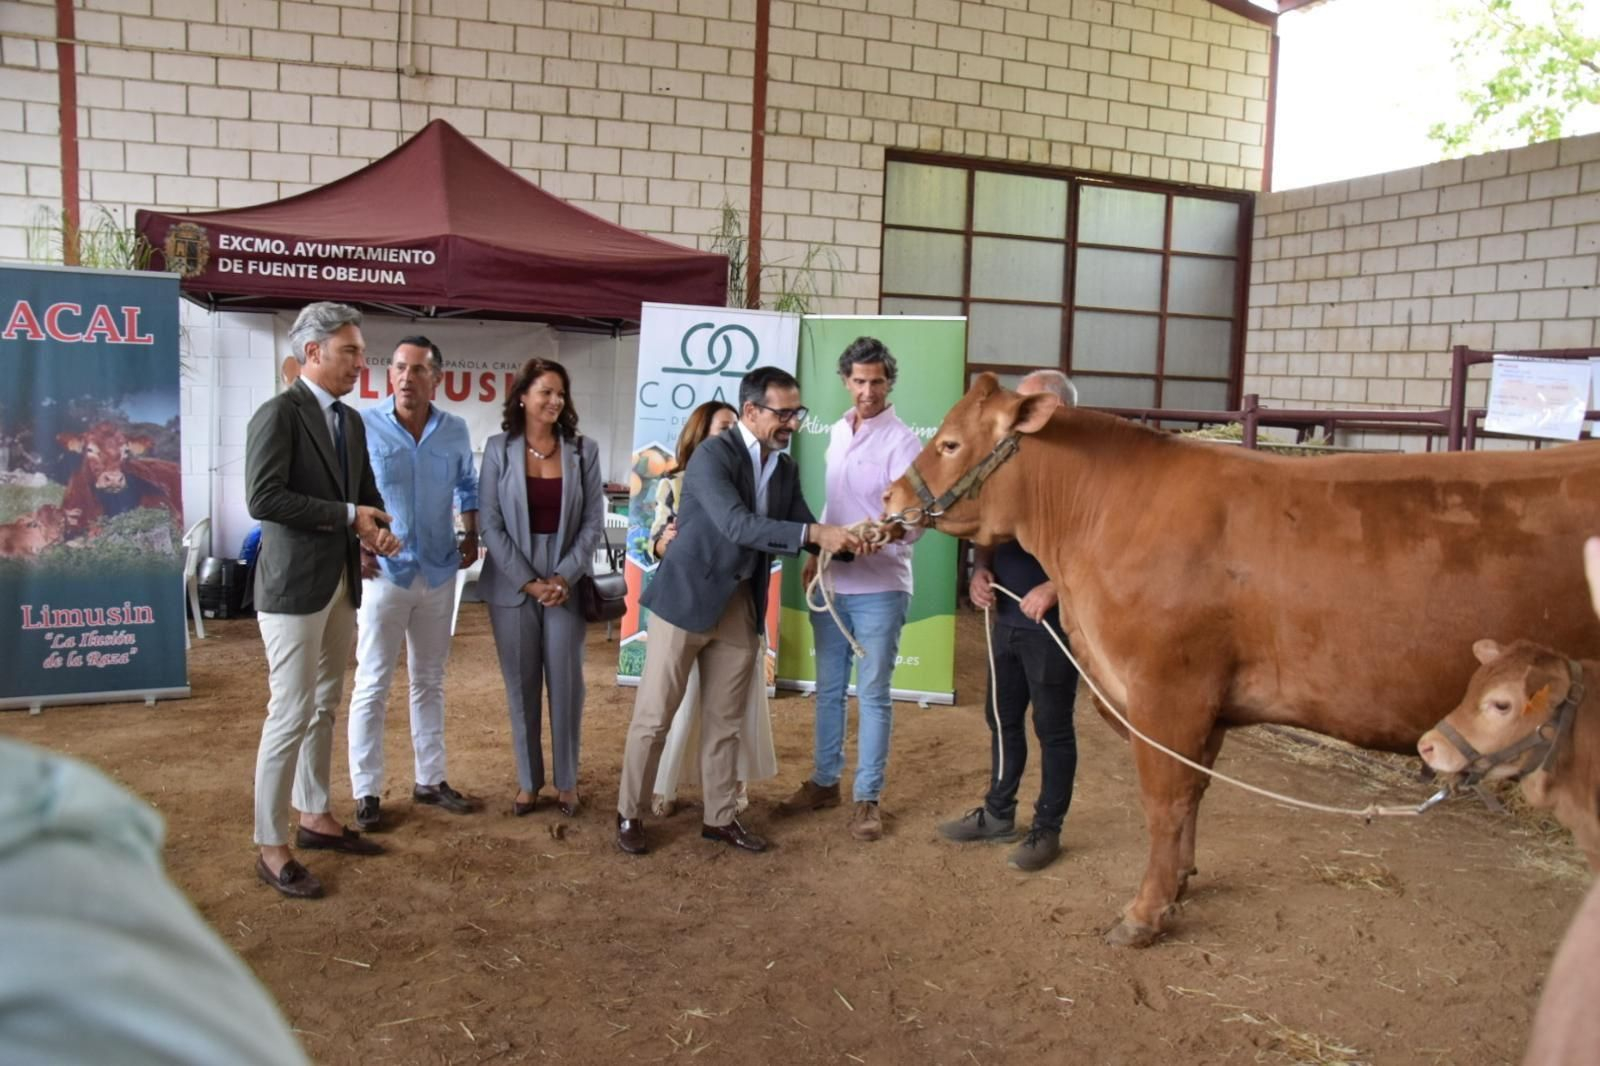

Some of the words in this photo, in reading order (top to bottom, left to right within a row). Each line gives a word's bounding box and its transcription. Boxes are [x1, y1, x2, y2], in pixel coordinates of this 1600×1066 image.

[218, 234, 290, 256] EXCMO.
[293, 241, 436, 265] AYUNTAMIENTO
[218, 257, 244, 274] DE
[247, 260, 318, 280] FUENTE
[321, 265, 406, 285] OBEJUNA
[1, 299, 154, 345] ACAL
[21, 601, 155, 629] Limusin
[42, 652, 64, 669] de
[66, 650, 84, 667] la
